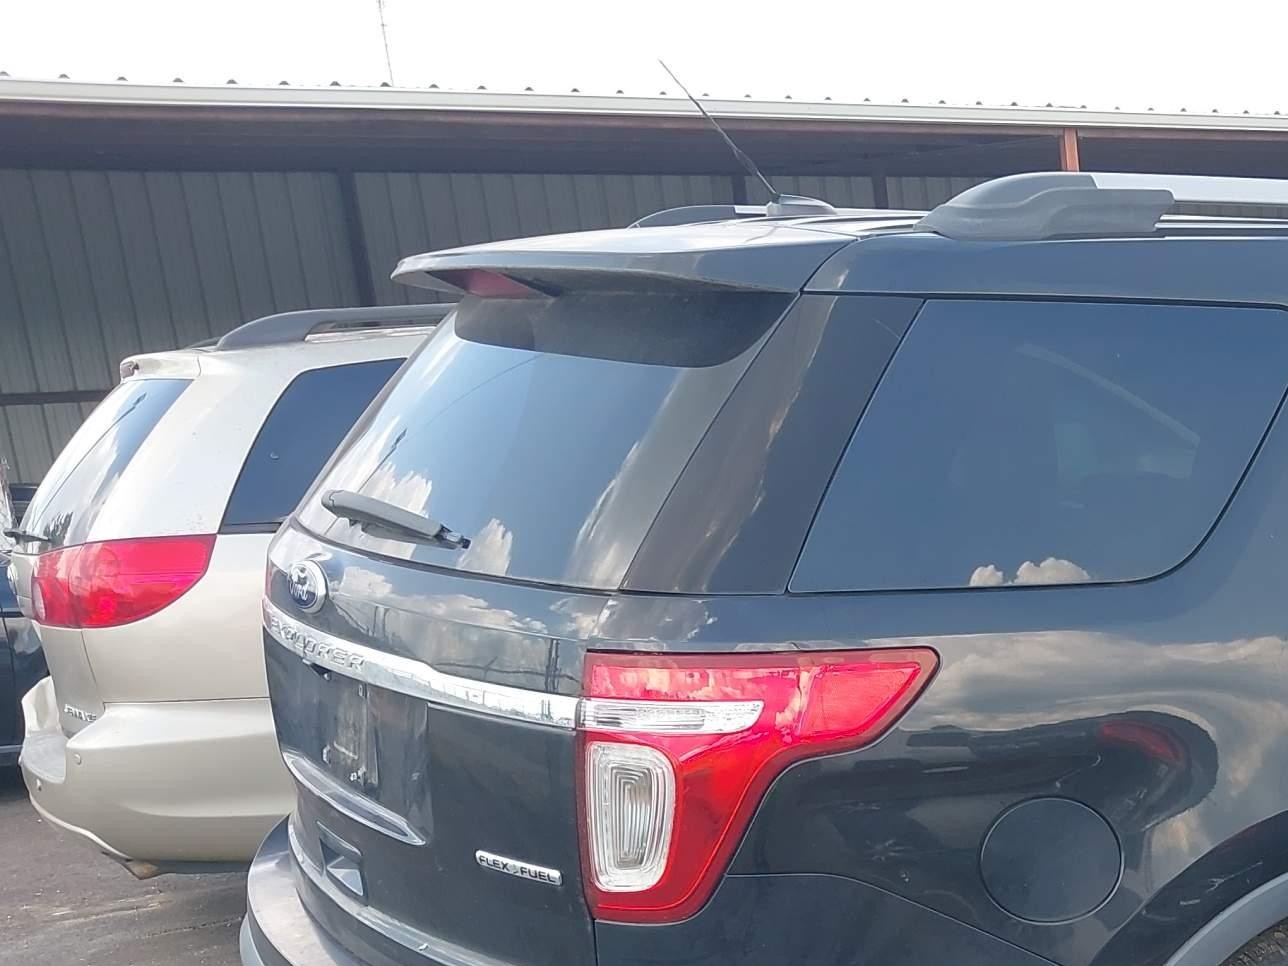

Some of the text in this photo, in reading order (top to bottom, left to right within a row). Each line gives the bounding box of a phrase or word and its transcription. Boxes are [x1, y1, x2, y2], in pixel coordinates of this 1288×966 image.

[289, 568, 317, 601] Ford
[270, 615, 366, 673] EXPLORER
[479, 855, 556, 883] FLEX FUEL
